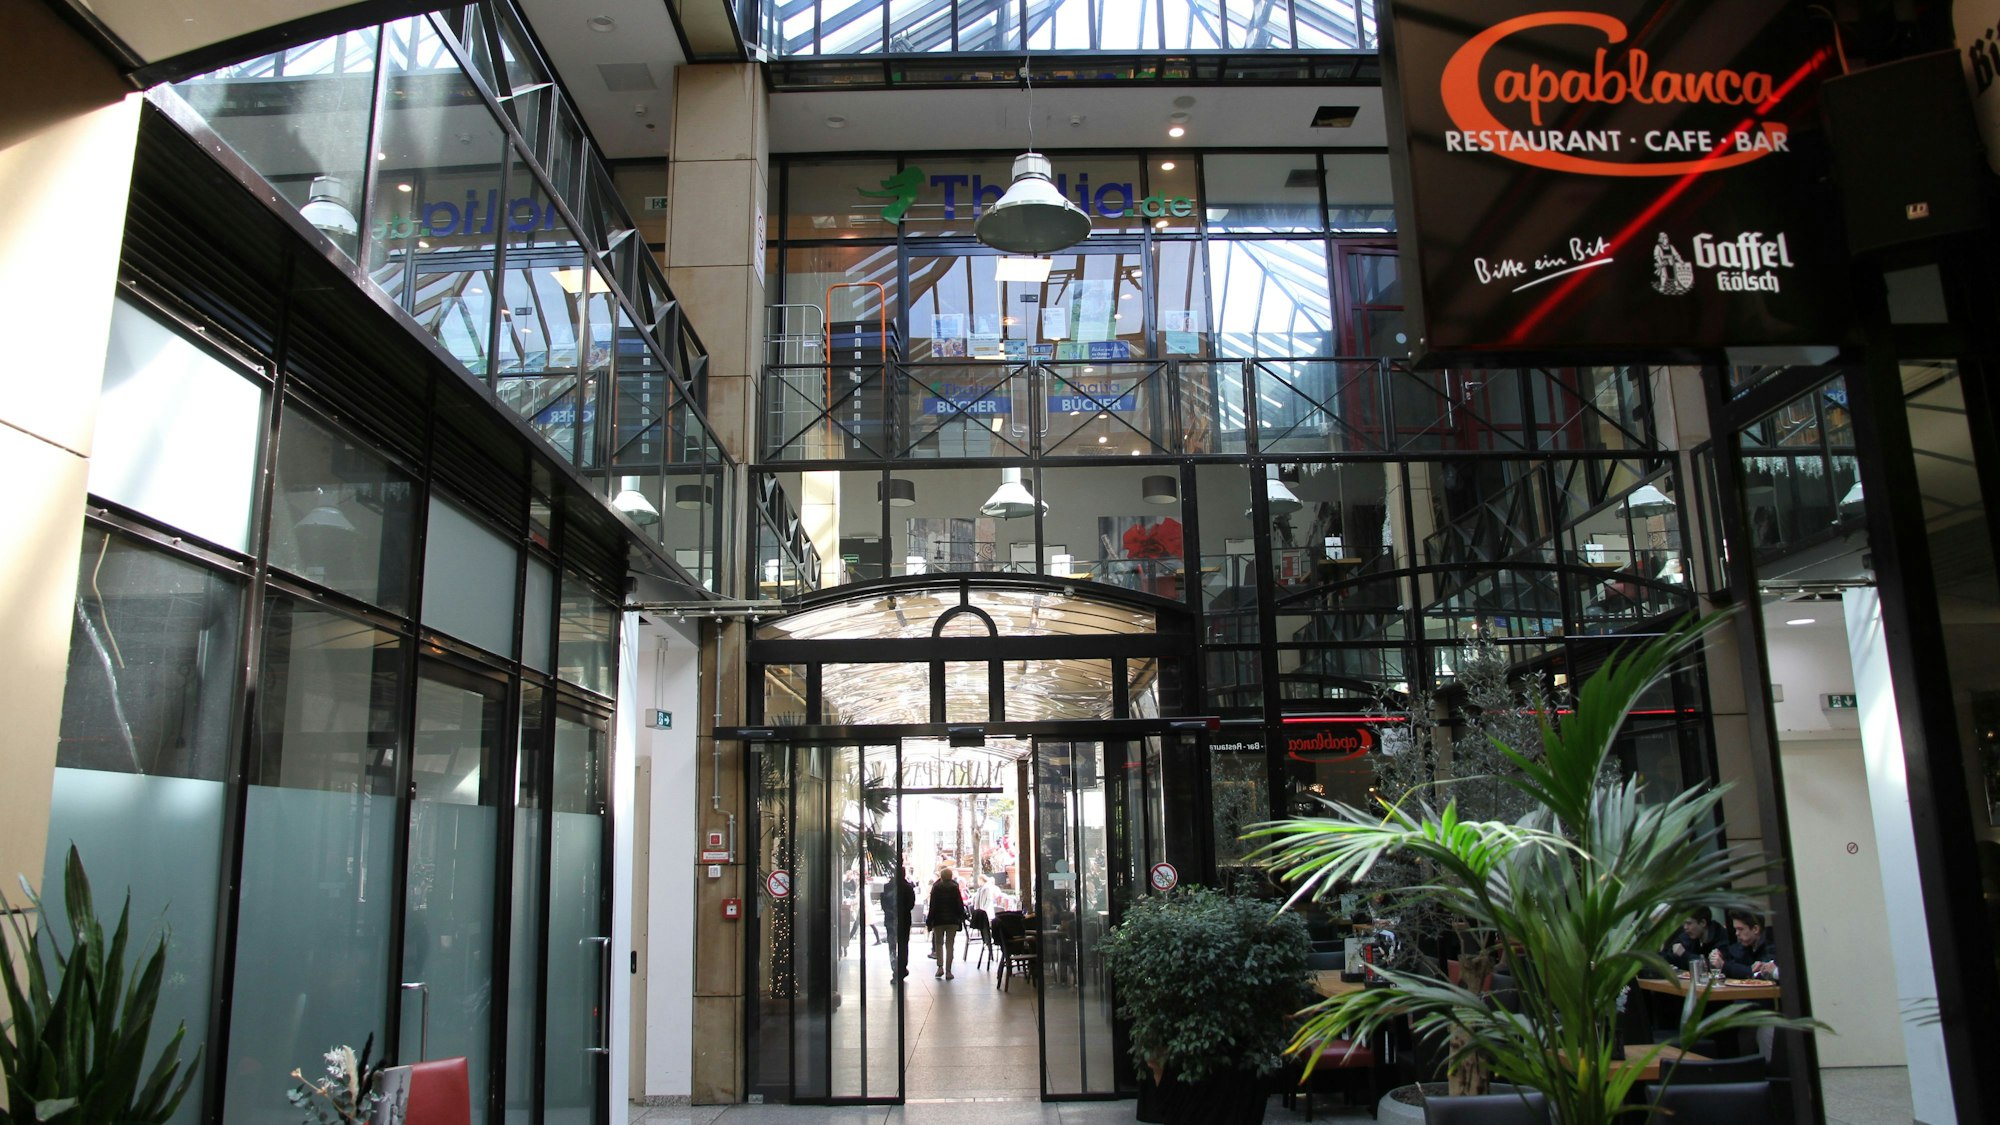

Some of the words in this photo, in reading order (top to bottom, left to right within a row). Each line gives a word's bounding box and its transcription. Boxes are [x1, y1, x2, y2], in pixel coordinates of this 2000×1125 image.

[1440, 11, 1789, 177] Capablanca
[1445, 130, 1621, 152] RESTAURANT
[1645, 130, 1712, 152] CAFE
[1735, 131, 1790, 152] BAR
[1474, 257, 1527, 284] Bitte
[1535, 255, 1567, 270] ein
[1569, 236, 1610, 262] Bit
[1693, 232, 1795, 271] Gaffel
[936, 397, 997, 413] BÜCHER
[1061, 396, 1122, 411] BÜCHER
